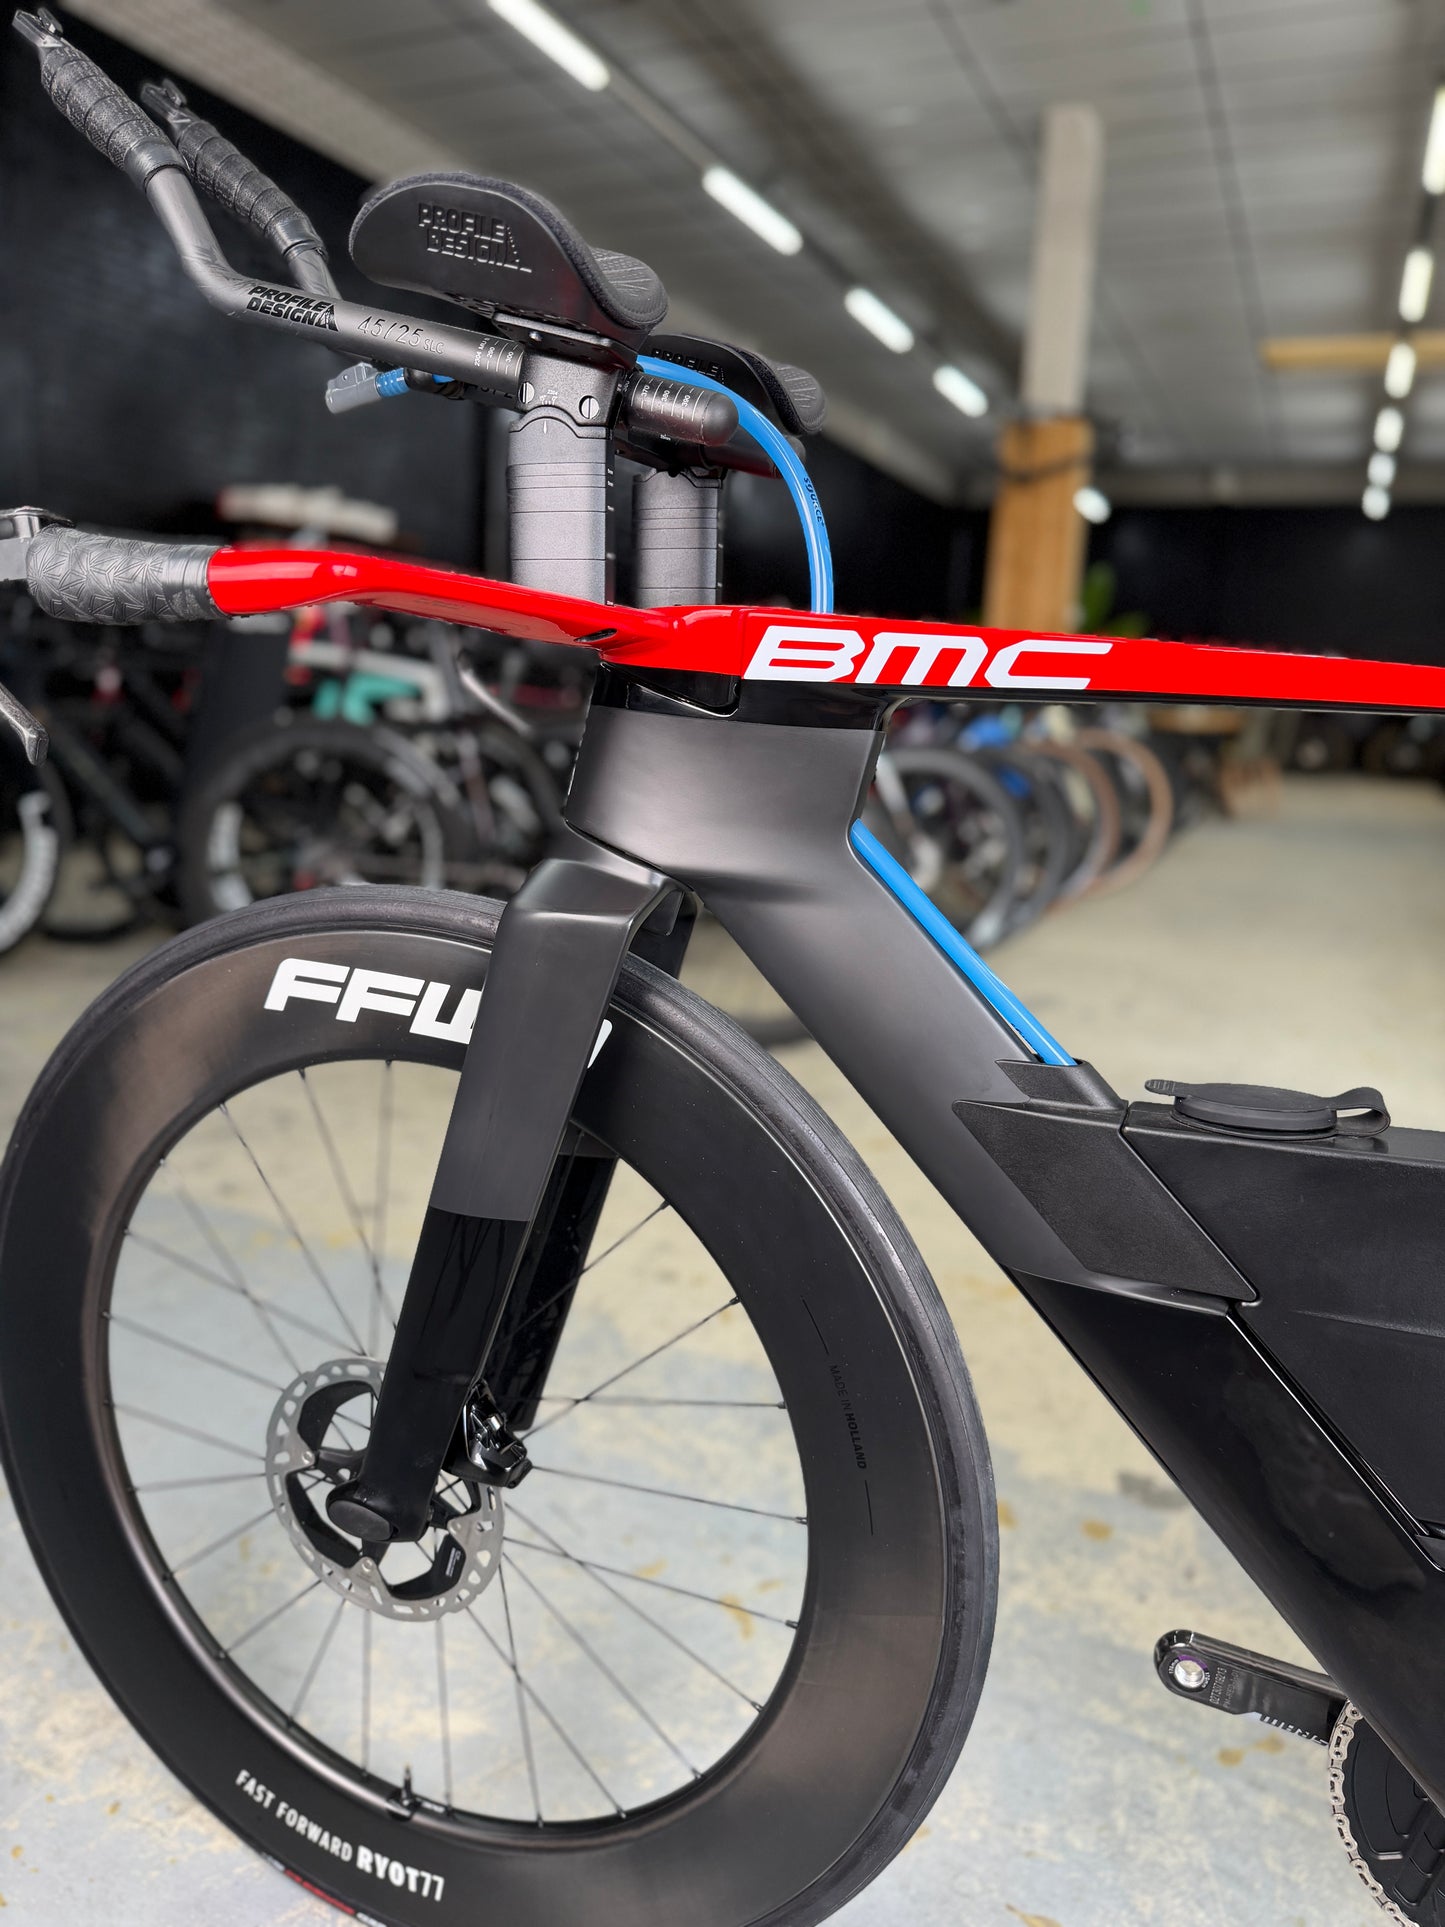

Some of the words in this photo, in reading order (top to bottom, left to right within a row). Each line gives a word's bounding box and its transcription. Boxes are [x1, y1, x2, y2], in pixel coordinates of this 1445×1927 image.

[418, 202, 505, 243] PROFILE
[427, 228, 508, 267] DESIGN
[246, 296, 319, 327] DESIGN
[247, 285, 332, 312] PROFILE
[357, 315, 424, 348] 45/25
[743, 625, 1114, 690] BMC
[830, 1365, 848, 1397] MADE
[841, 1400, 852, 1410] IN
[845, 1412, 867, 1469] HOLLAND
[234, 1769, 276, 1809] FAST
[276, 1801, 353, 1862] FORWARD
[356, 1845, 445, 1901] RYOT77
